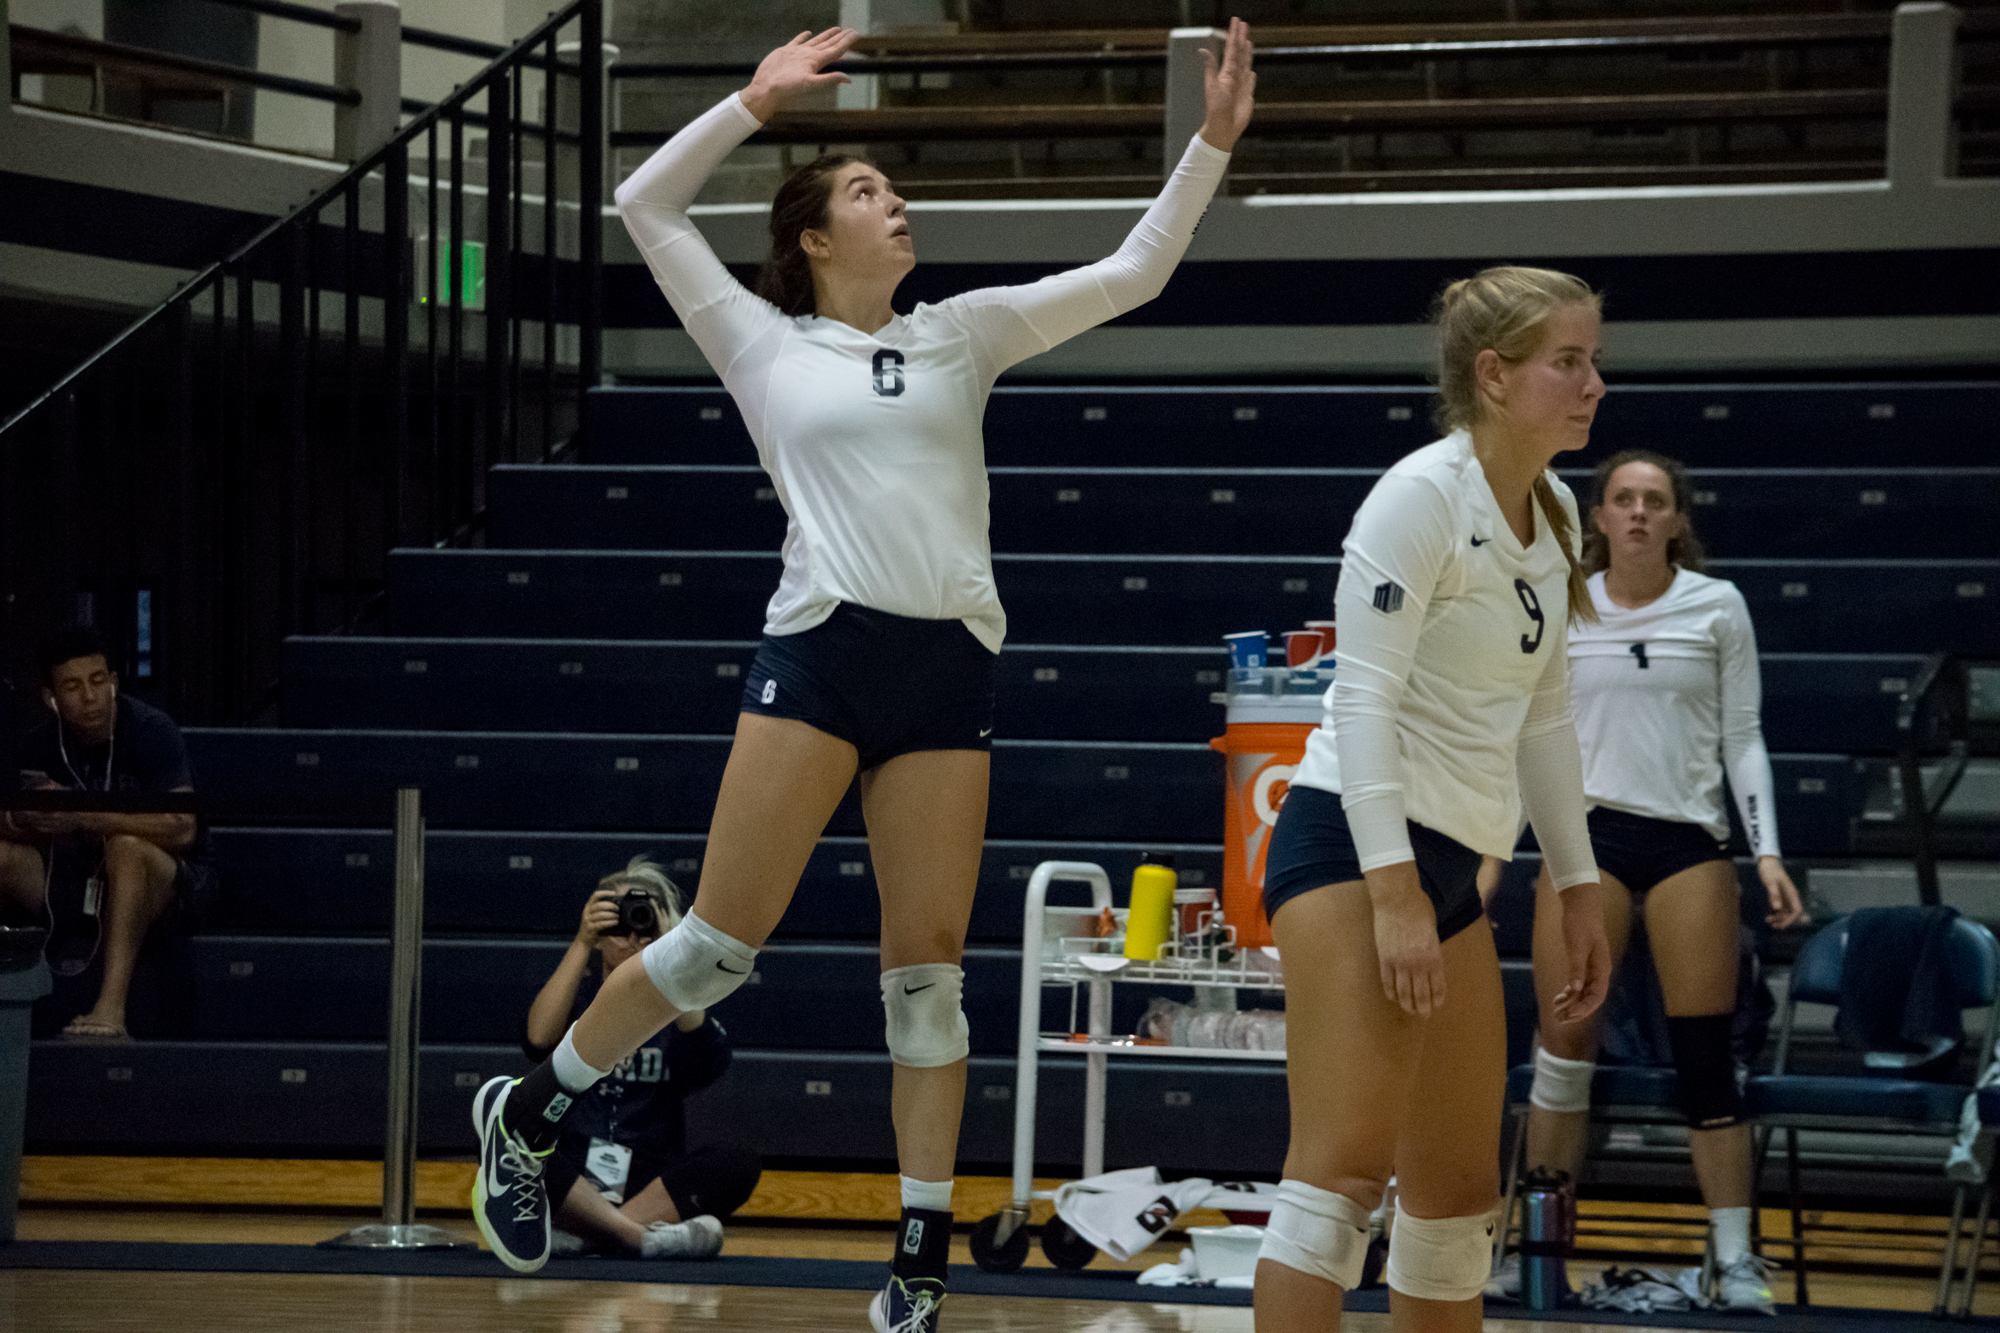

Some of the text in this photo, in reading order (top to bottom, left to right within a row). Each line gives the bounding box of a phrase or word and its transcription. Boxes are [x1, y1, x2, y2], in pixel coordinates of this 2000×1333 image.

[872, 348, 905, 397] 6
[1514, 578, 1545, 654] 9
[1630, 642, 1649, 669] 1
[761, 679, 777, 705] 6
